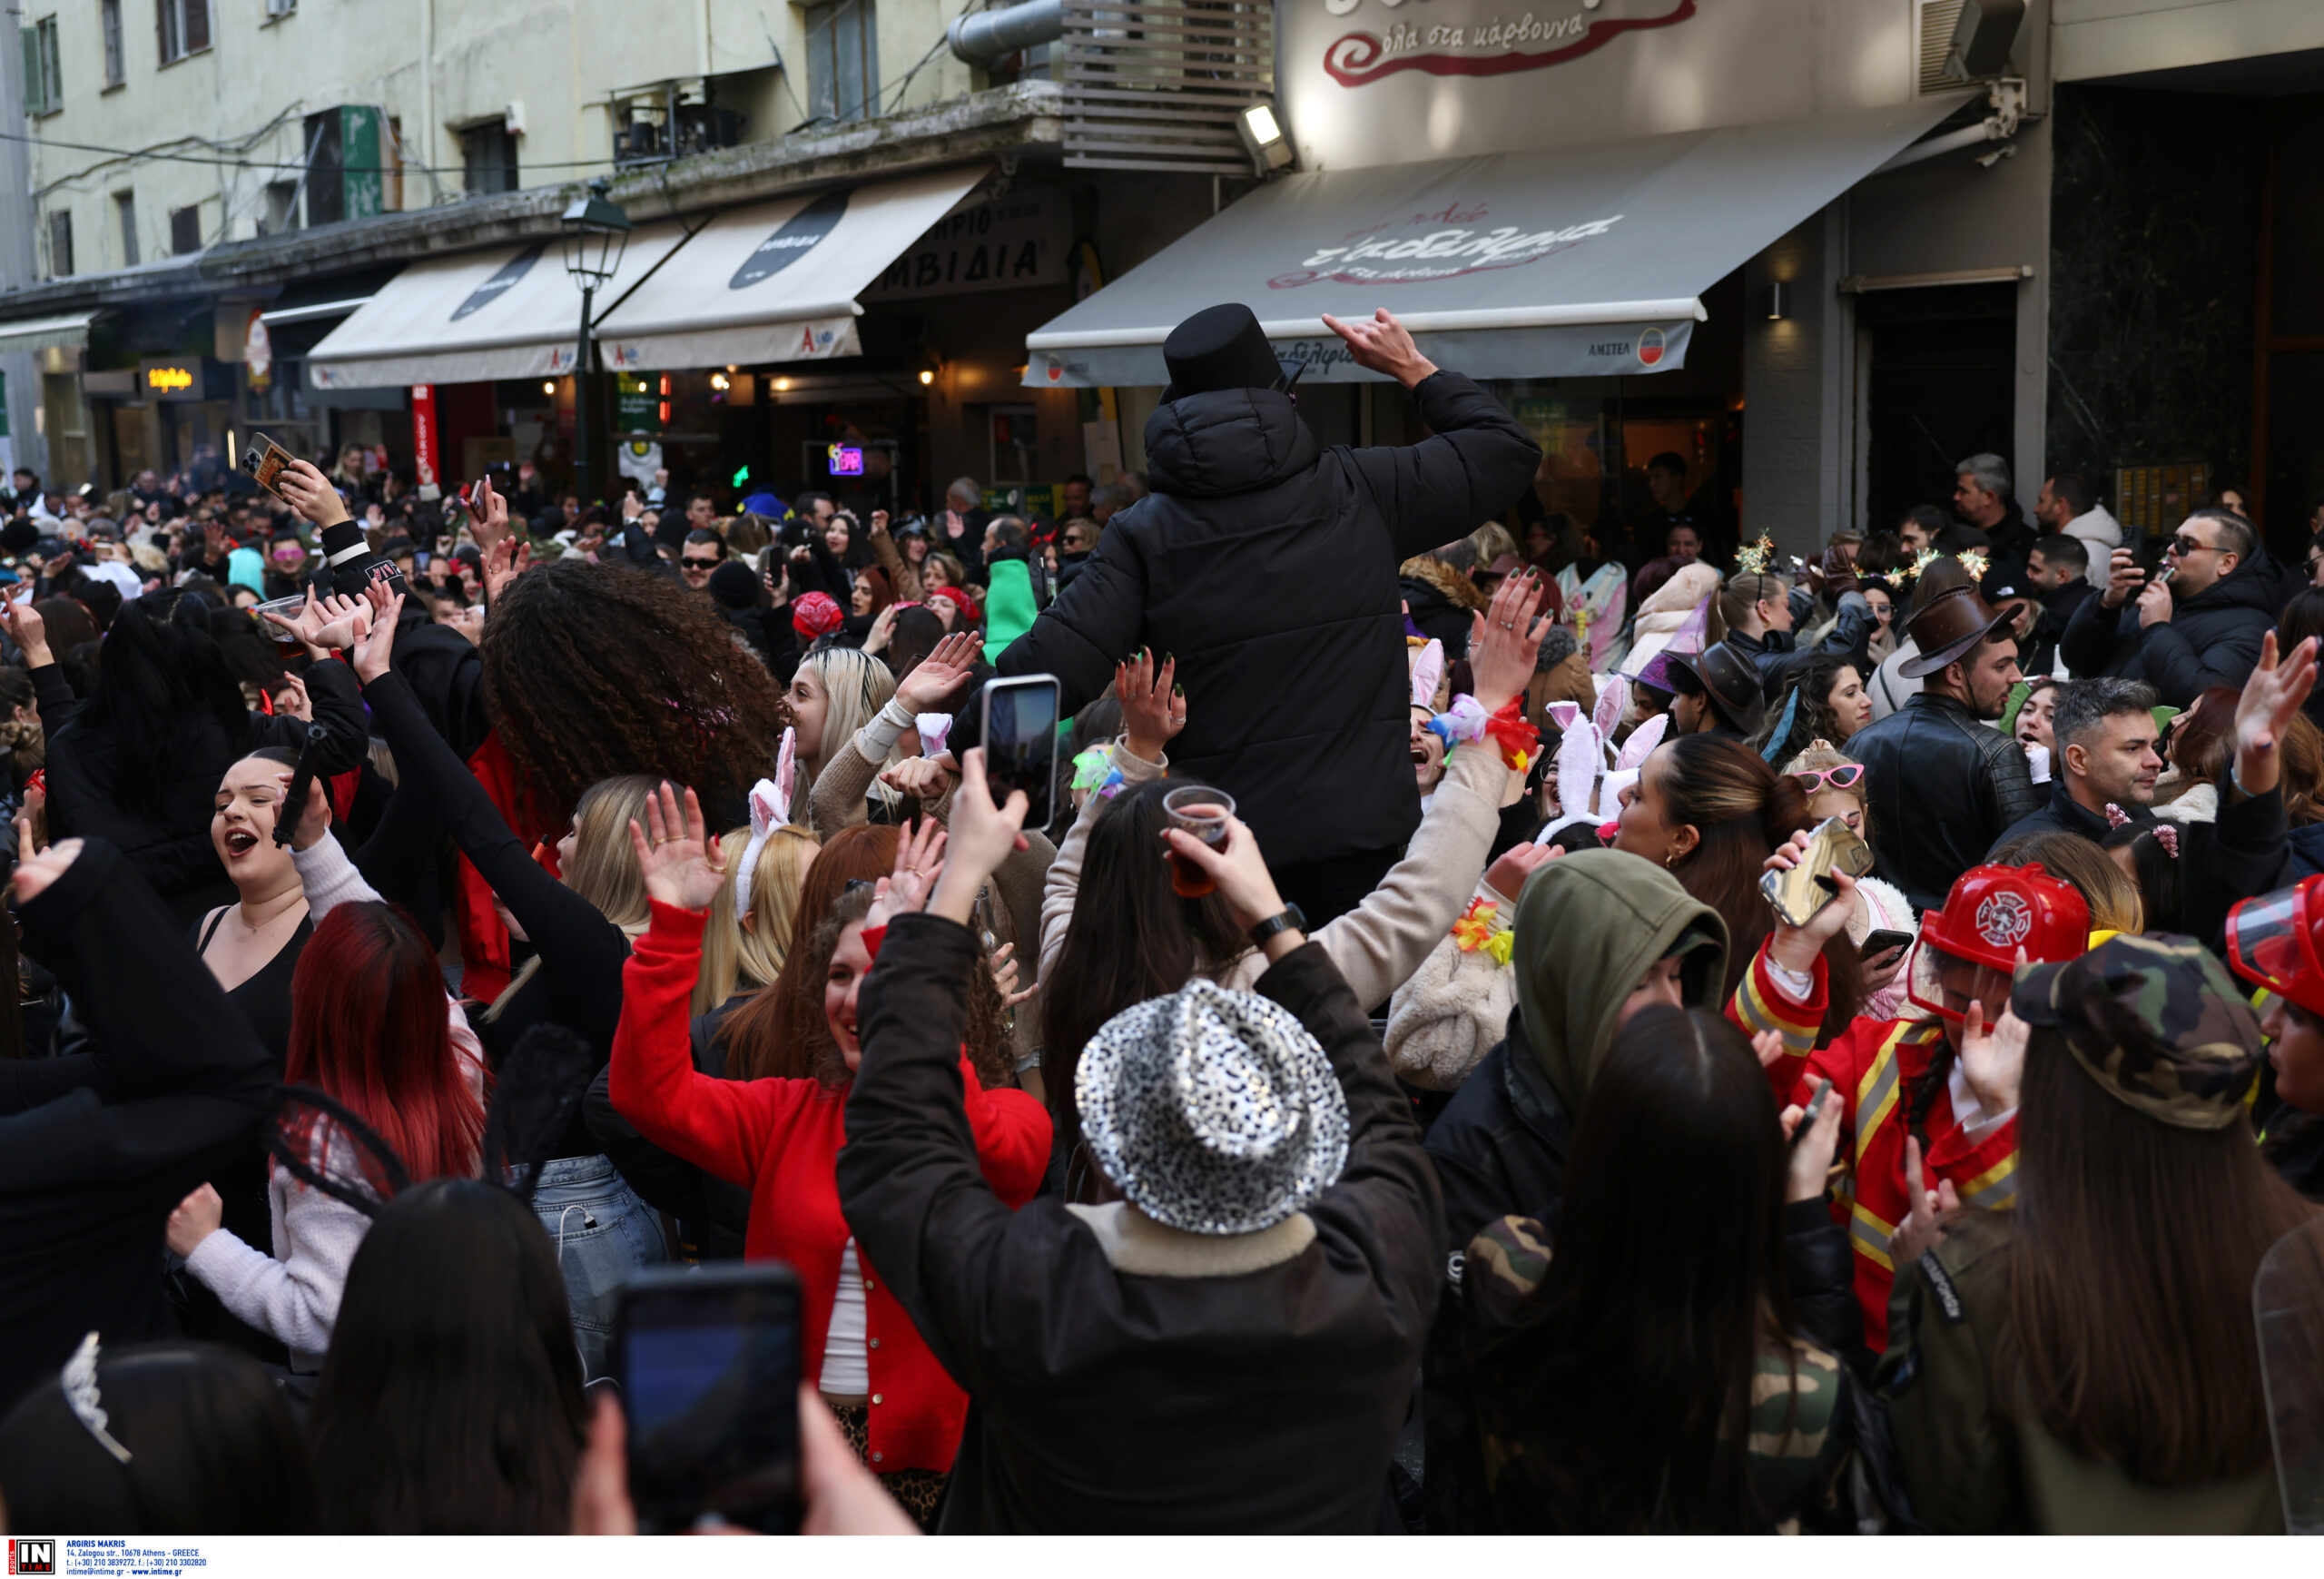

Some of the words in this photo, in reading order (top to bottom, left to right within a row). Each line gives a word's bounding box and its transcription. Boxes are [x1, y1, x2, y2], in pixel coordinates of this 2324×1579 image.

[1383, 24, 1418, 53] όλα
[1428, 25, 1465, 46] στα
[1473, 13, 1584, 49] κάρβουνα
[921, 207, 992, 242] ΗΡΙΟ
[870, 240, 1038, 291] ΜΒΙΔΙΑ
